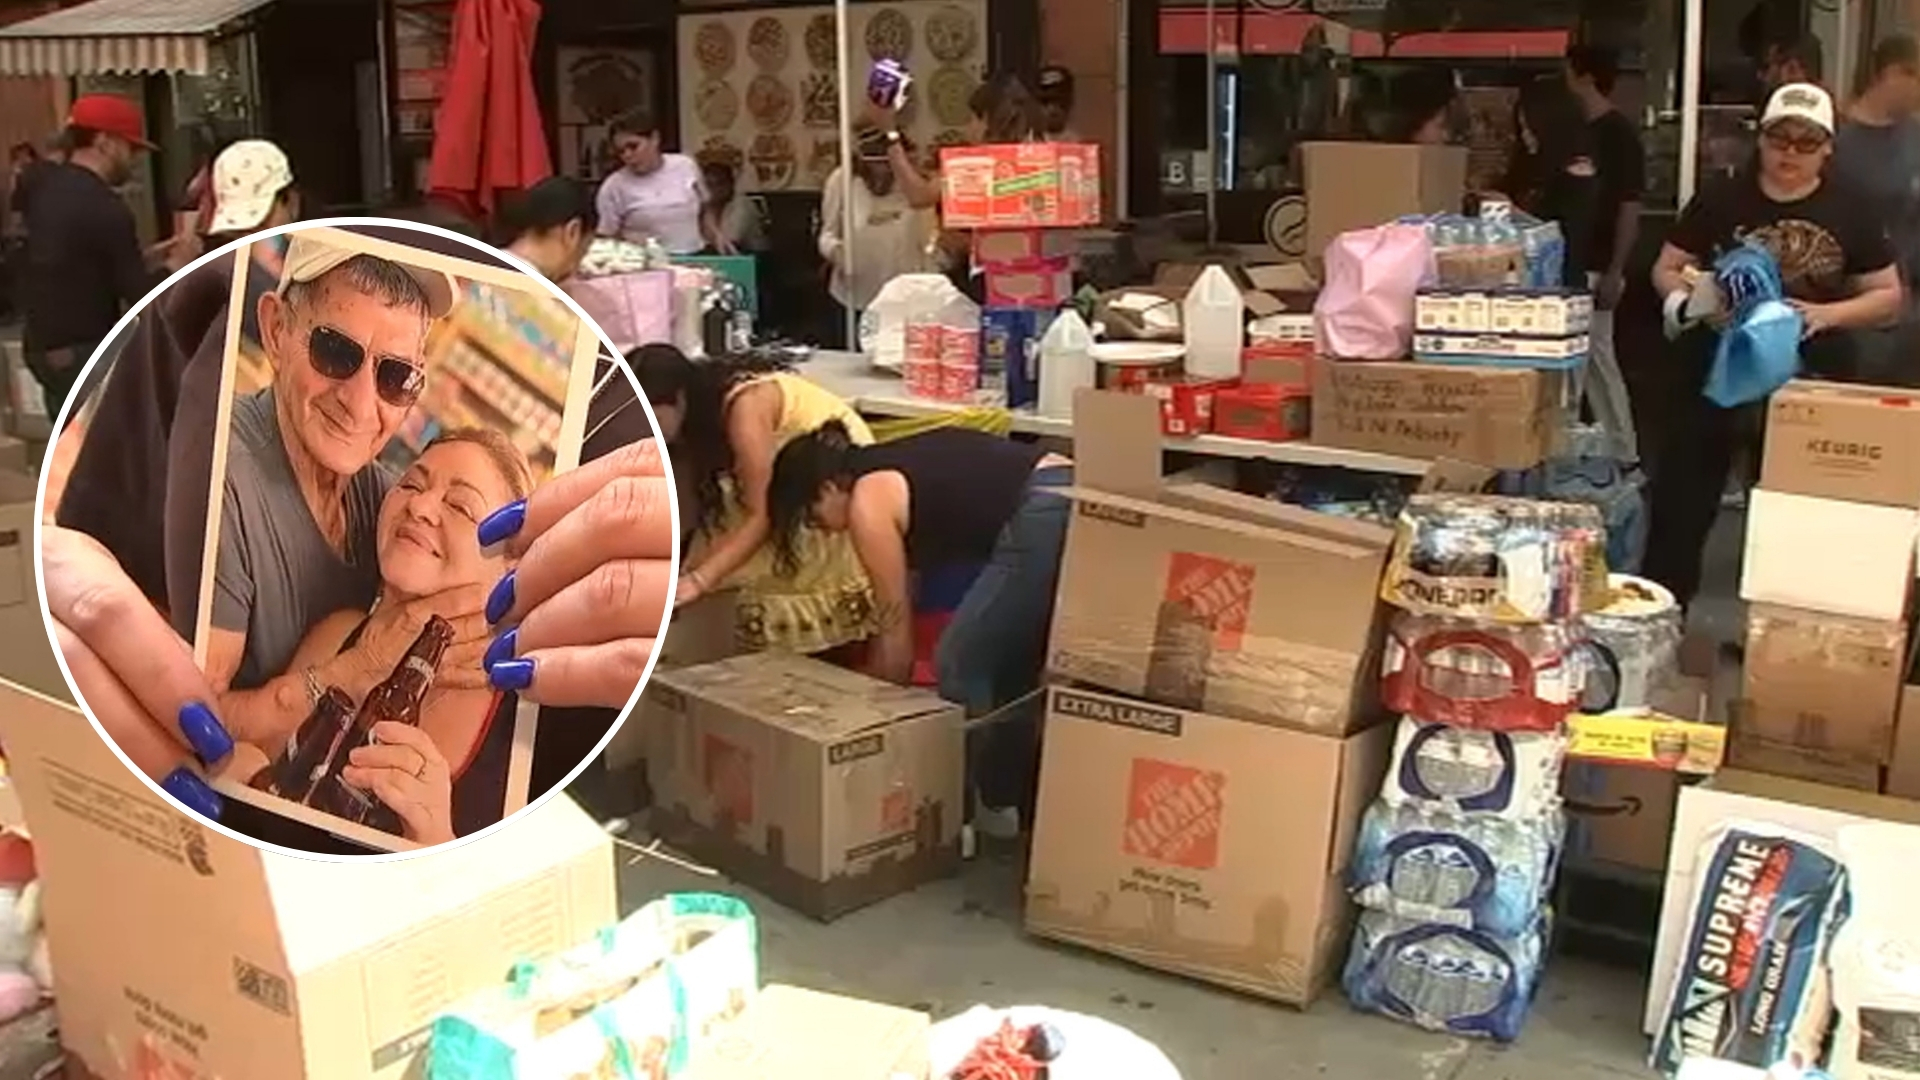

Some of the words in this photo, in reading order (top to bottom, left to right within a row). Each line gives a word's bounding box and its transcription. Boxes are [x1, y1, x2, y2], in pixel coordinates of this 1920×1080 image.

[1169, 162, 1186, 184] B
[1806, 440, 1882, 460] KEURIG
[1058, 695, 1113, 719] EXTRA
[1117, 707, 1176, 731] LARGE
[1698, 839, 1771, 976] SUPREME
[1751, 993, 1773, 1035] LONG
